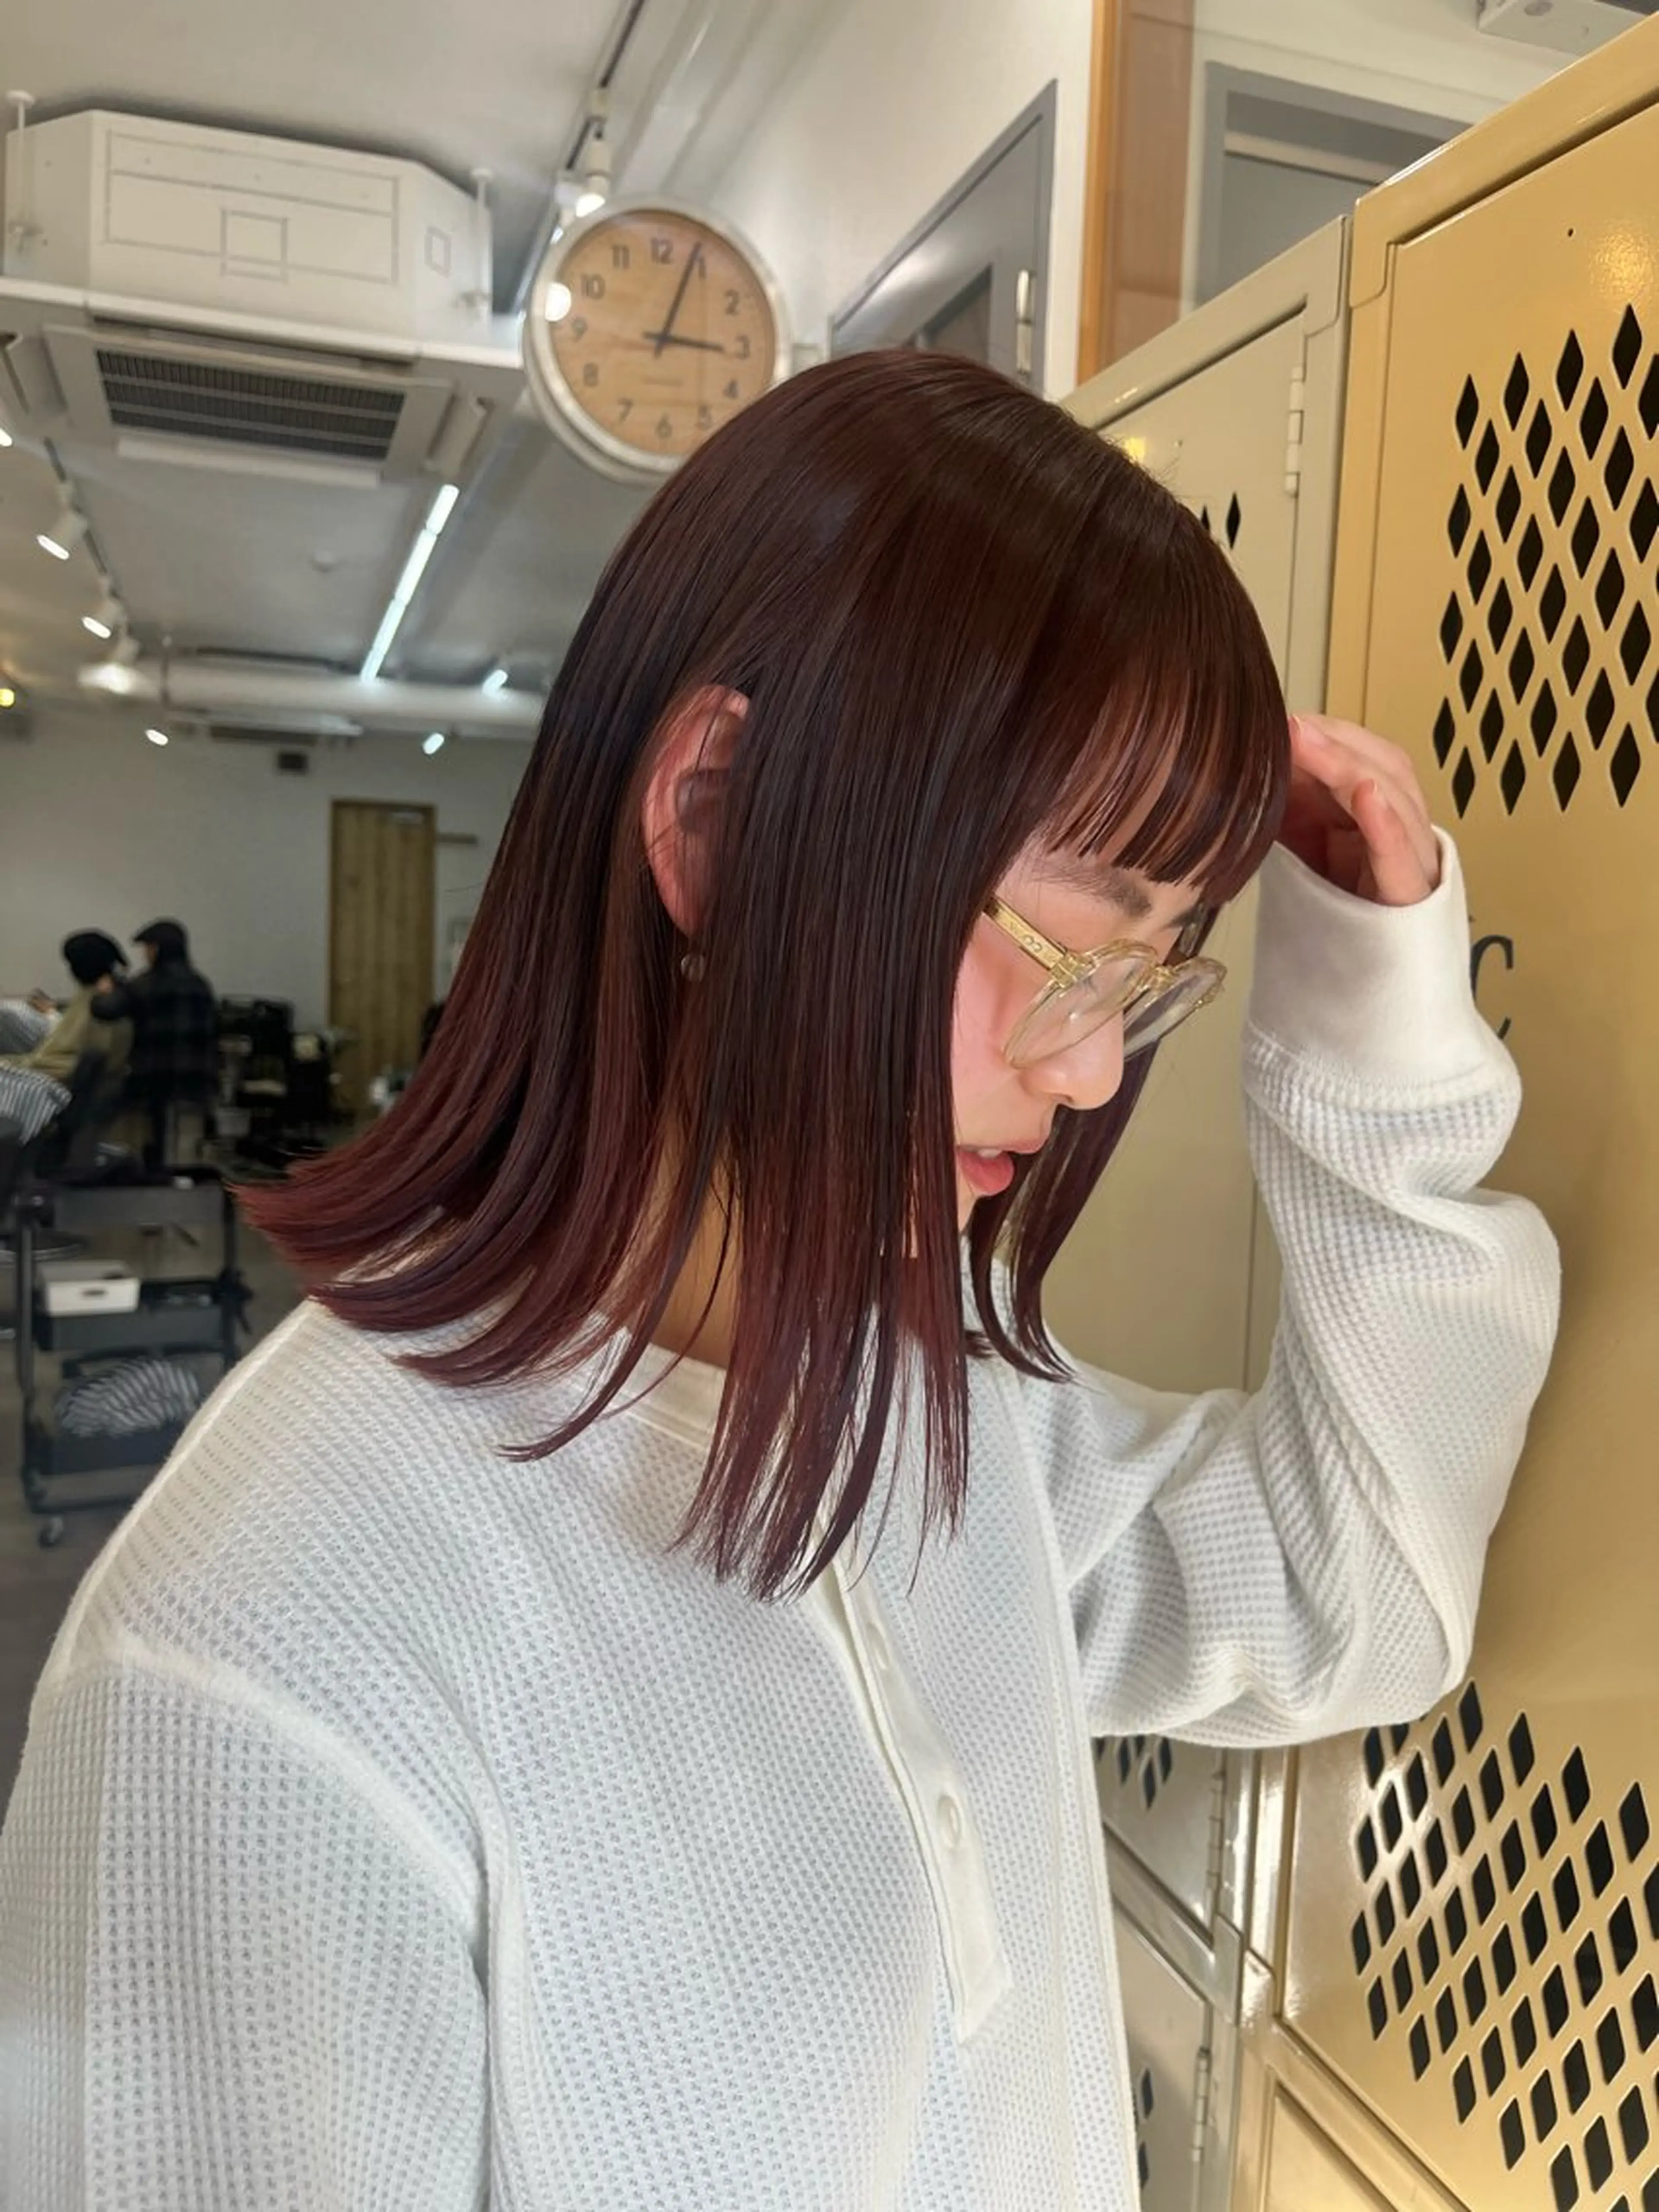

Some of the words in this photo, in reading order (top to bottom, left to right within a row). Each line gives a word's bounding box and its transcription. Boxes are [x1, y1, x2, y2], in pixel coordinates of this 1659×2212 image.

[611, 245, 630, 270] 11
[651, 238, 673, 264] 12
[581, 273, 606, 300] 10
[725, 290, 739, 315] 2
[571, 317, 588, 343] 9
[736, 335, 750, 359] 3
[724, 379, 738, 399] 4
[618, 398, 634, 422] 7
[655, 413, 673, 438] 6
